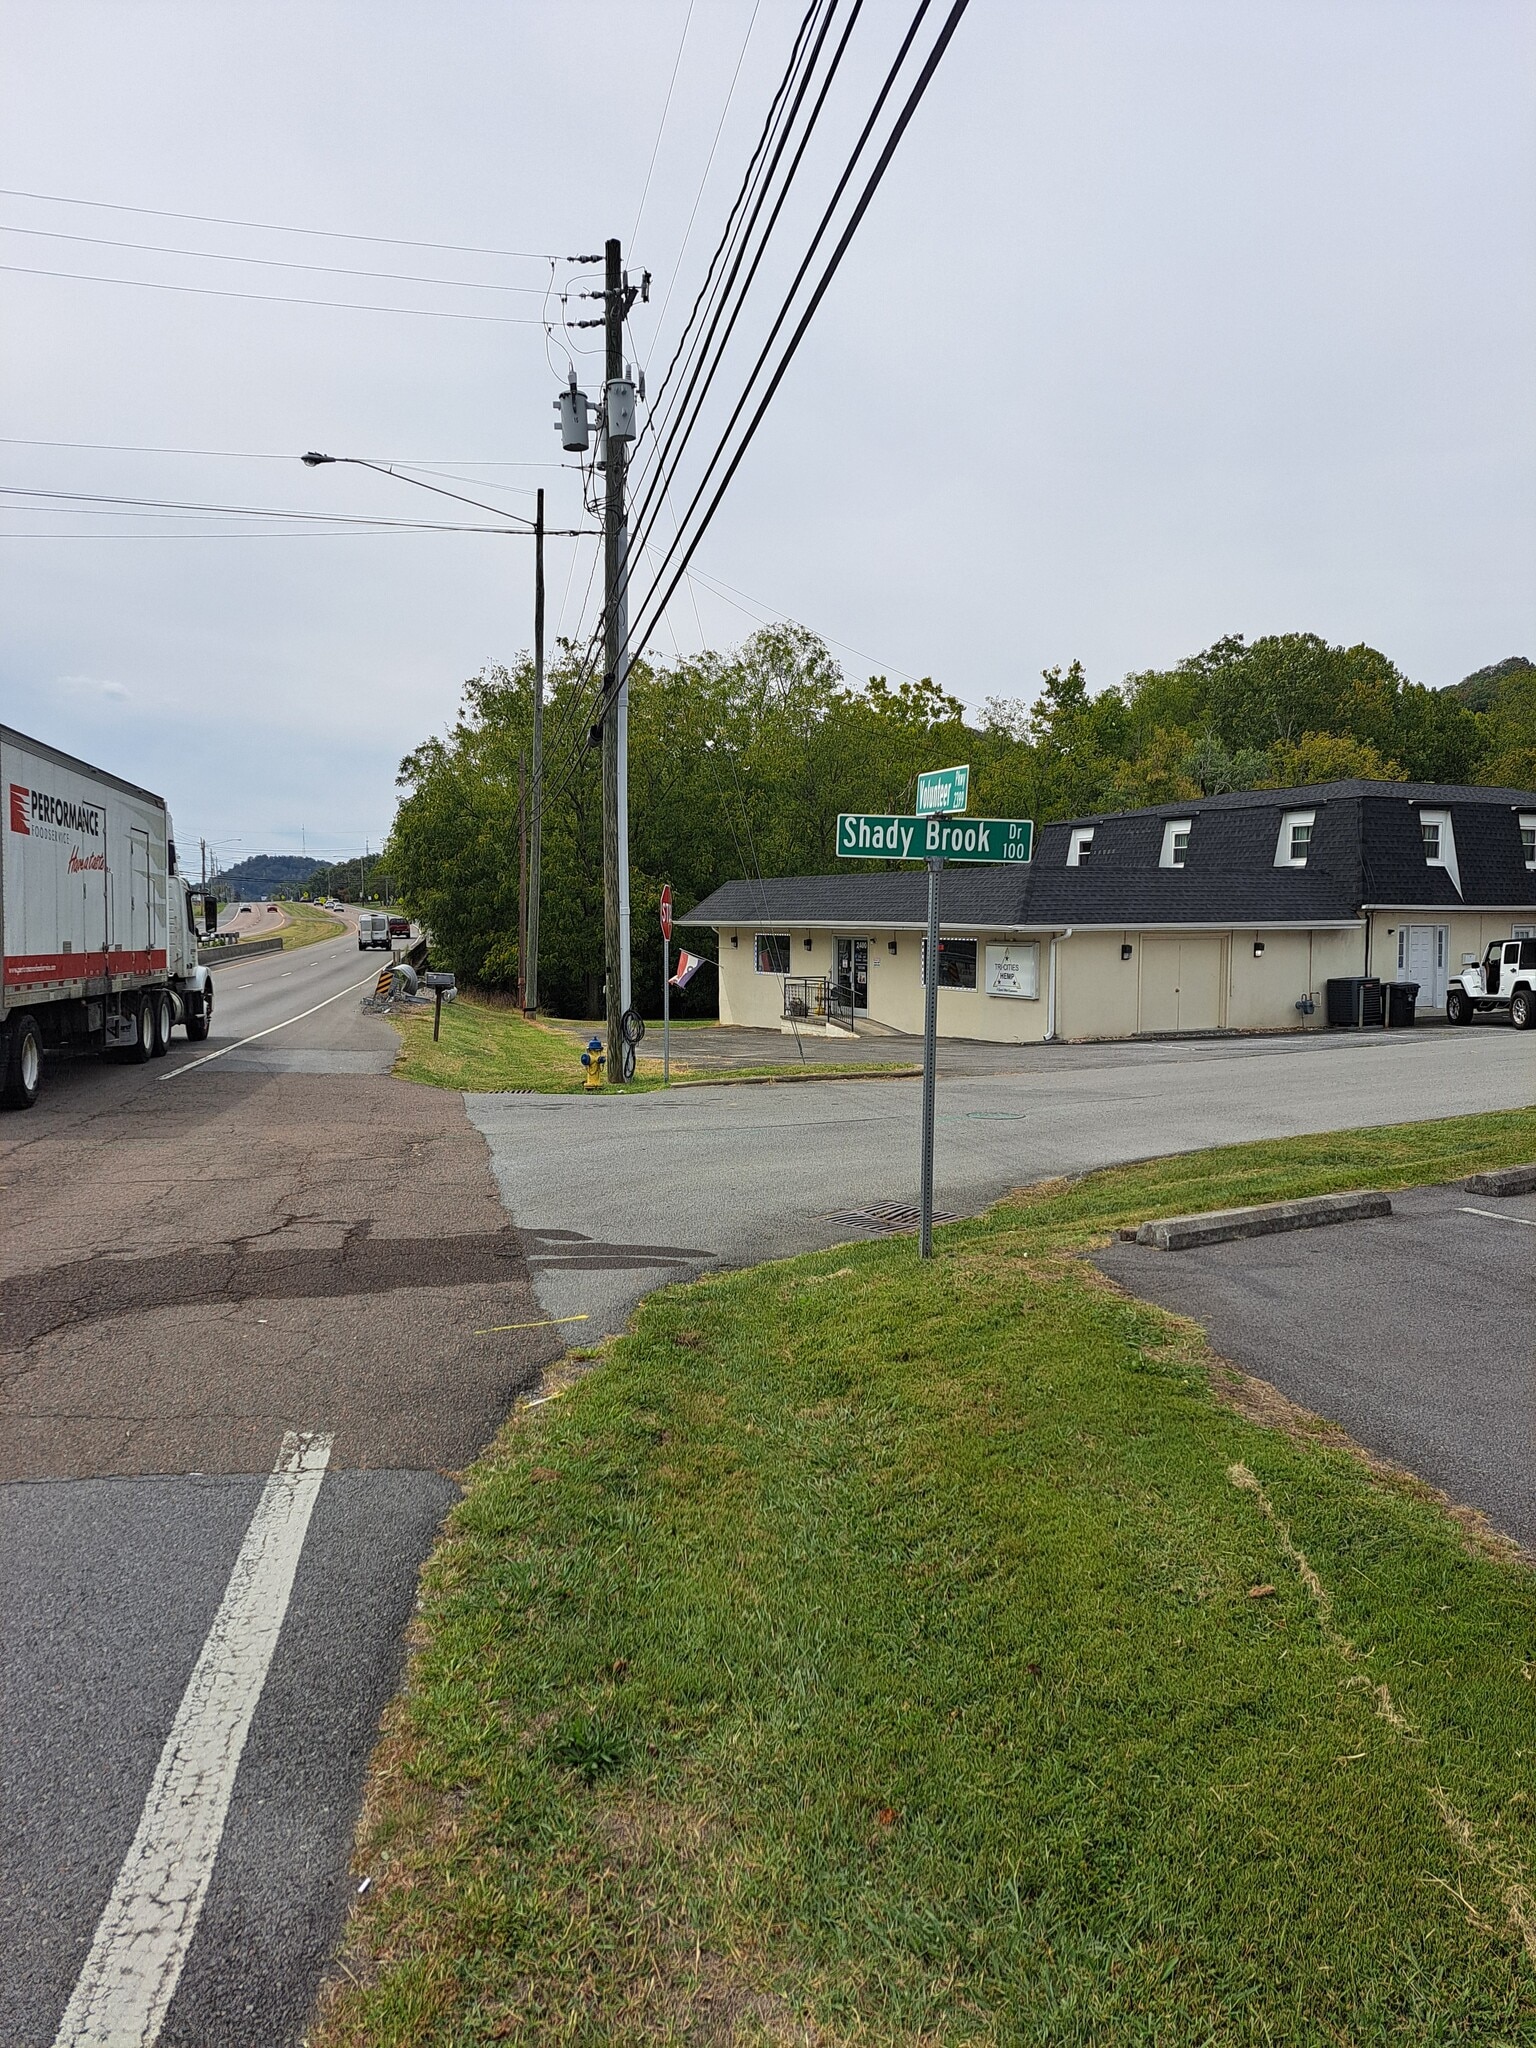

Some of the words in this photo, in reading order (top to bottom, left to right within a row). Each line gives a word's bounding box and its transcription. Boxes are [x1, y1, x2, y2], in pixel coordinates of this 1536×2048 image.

[954, 770, 966, 789] Pkwy
[919, 777, 952, 809] Volunteer
[953, 791, 965, 808] 2399
[31, 790, 99, 837] PERFORMANCE
[31, 824, 71, 845] FOODSERVICE
[843, 816, 915, 858] Shady
[925, 820, 991, 853] Brook
[1008, 823, 1023, 840] Dr
[1002, 842, 1025, 859] 100
[999, 972, 1015, 980] HEMP
